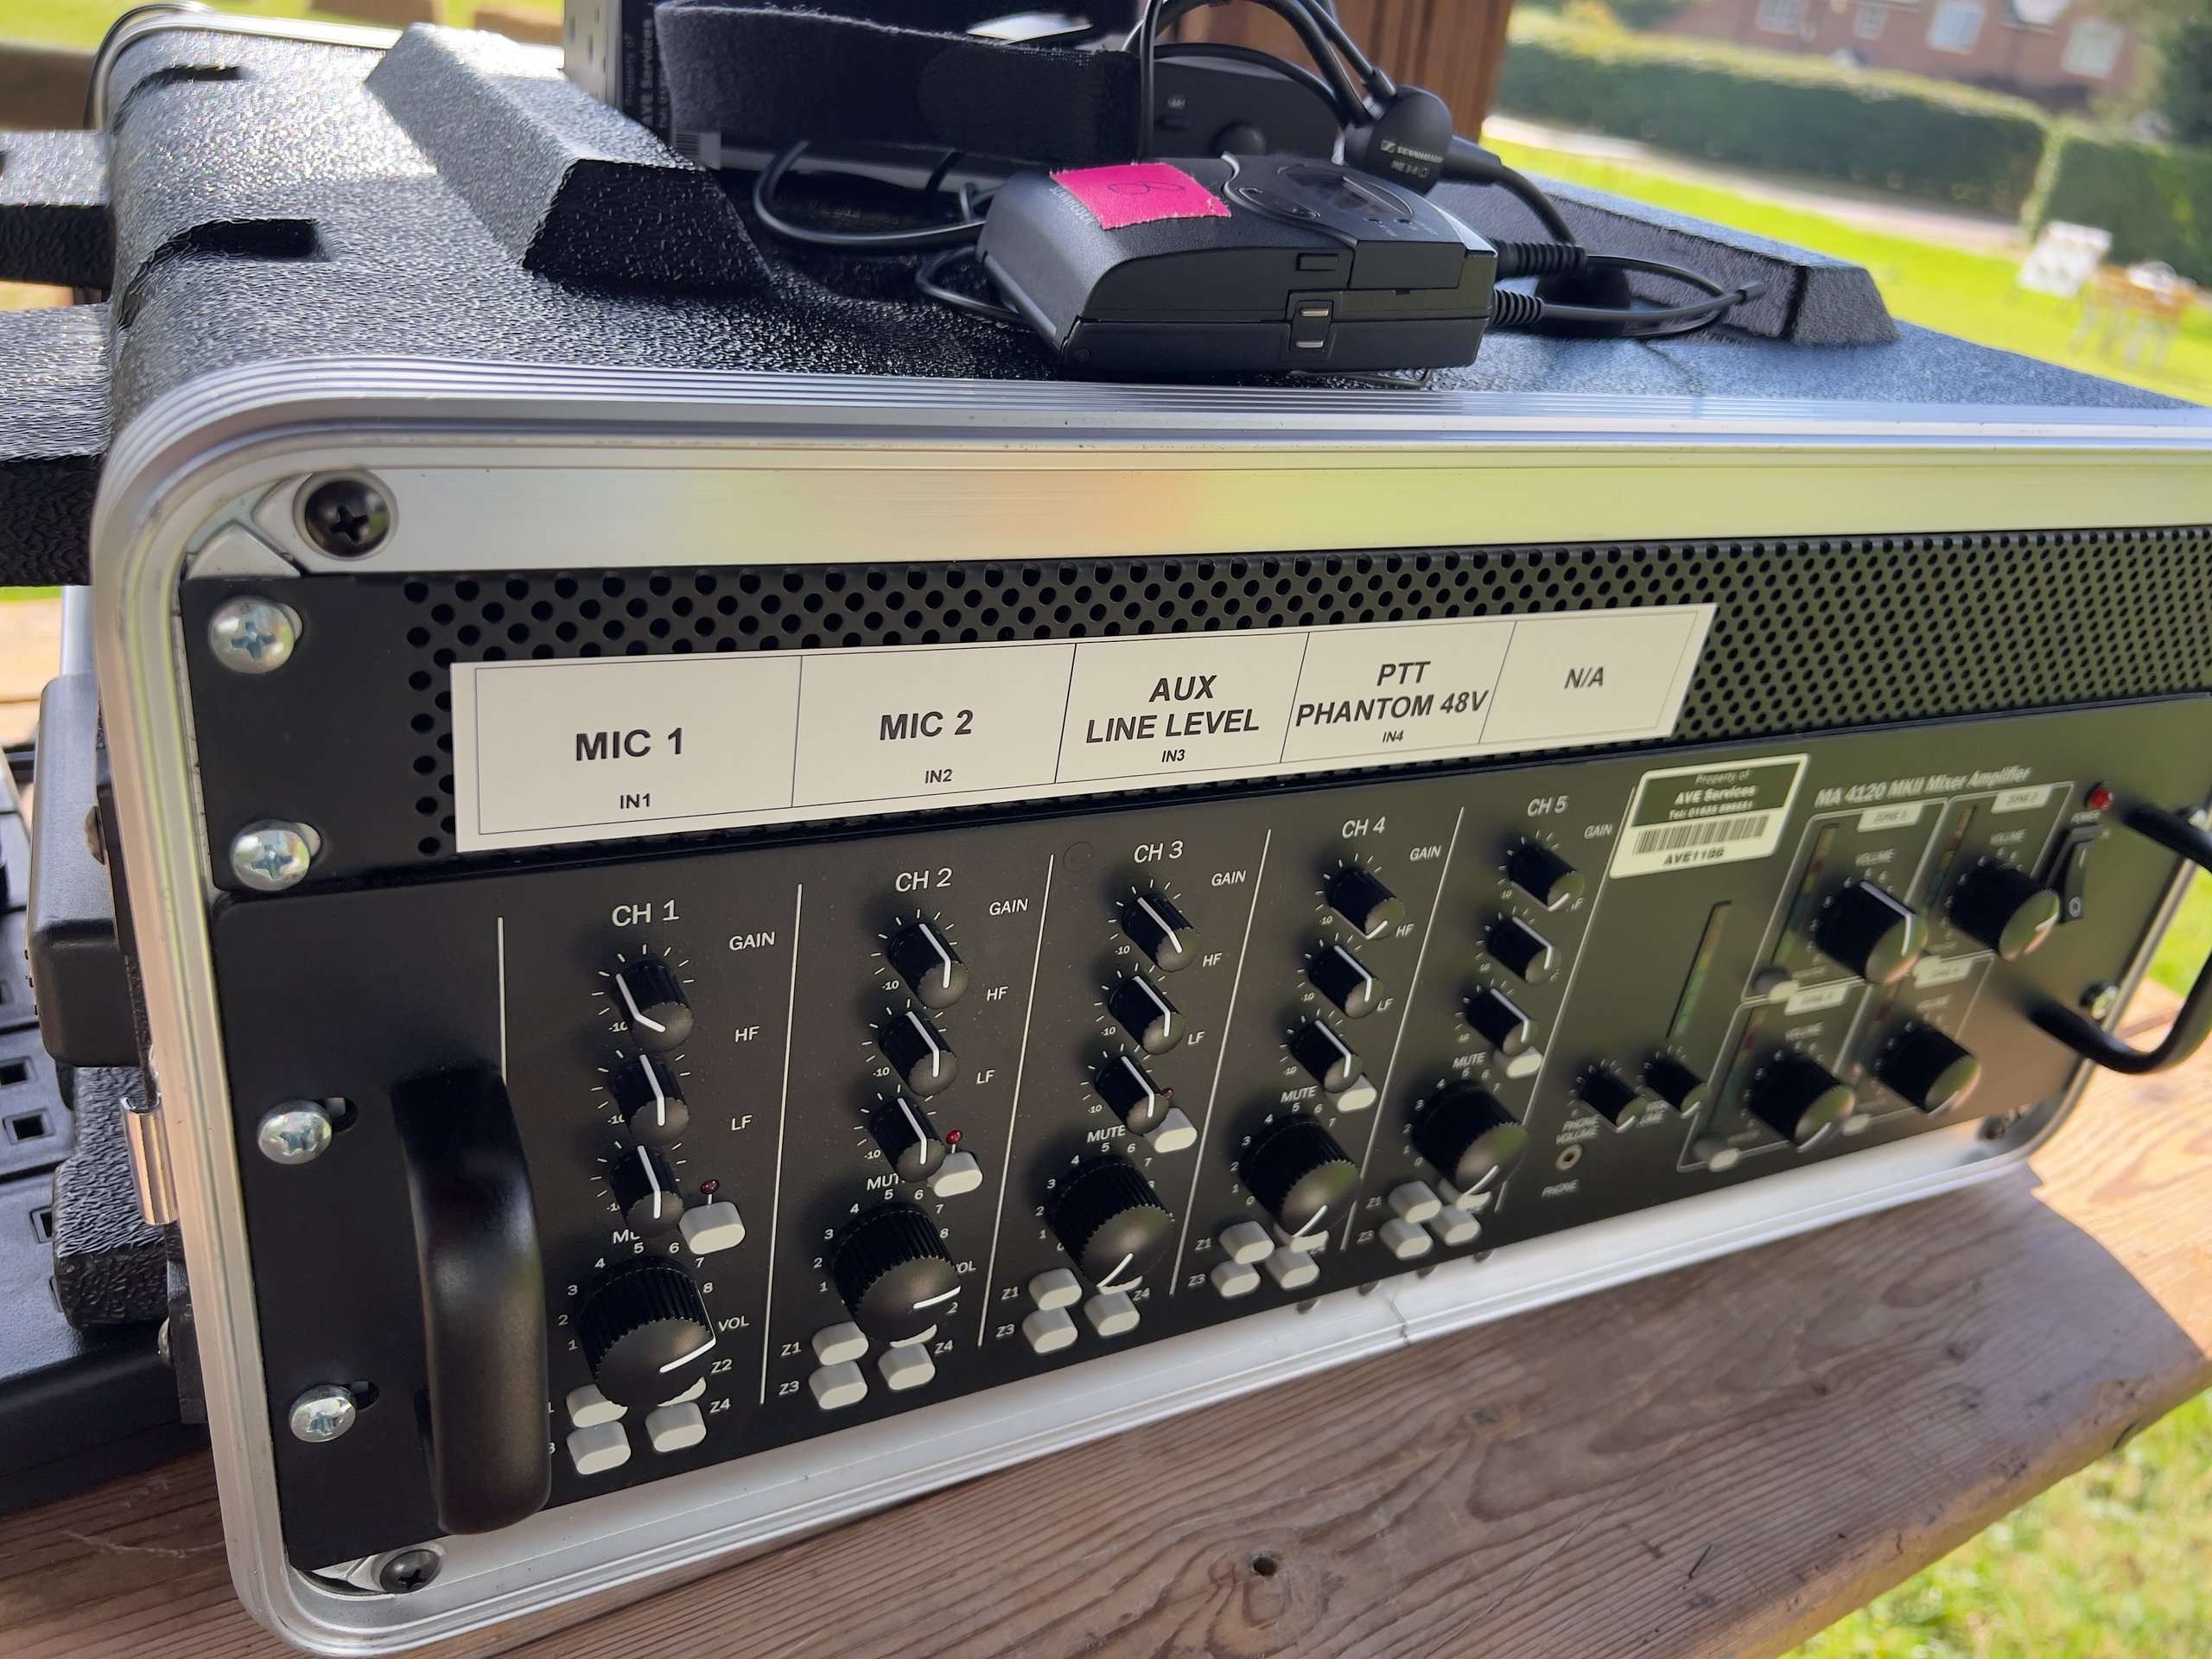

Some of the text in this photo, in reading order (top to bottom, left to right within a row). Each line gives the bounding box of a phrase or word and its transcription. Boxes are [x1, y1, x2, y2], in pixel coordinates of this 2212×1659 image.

[1376, 661, 1430, 686] PTT
[1564, 666, 1605, 690] N/A
[1149, 675, 1216, 702] AUX
[1296, 690, 1489, 727] PHANTOM 48V
[880, 709, 974, 741] MIC 2
[1086, 709, 1260, 744] LINE LEVEL
[1382, 728, 1404, 743] IN4
[575, 728, 683, 761] MIC 1
[1161, 748, 1185, 763] IN3
[925, 769, 953, 784] IN2
[1815, 787, 1842, 808] MA
[1845, 781, 1887, 803] 4120
[1925, 774, 1967, 793] Mixer
[1967, 765, 2031, 788] Amplifier
[620, 793, 652, 810] IN1
[1675, 785, 1758, 805] AVE Services
[1527, 795, 1569, 817] CH 5
[1342, 816, 1386, 839] CH 4
[1584, 823, 1613, 840] GAIN
[1134, 841, 1185, 863] CH 3
[1409, 845, 1441, 862] GAIN
[895, 868, 953, 893] CH 2
[1211, 870, 1246, 887] GAIN
[612, 899, 680, 926] CH 1
[988, 898, 1028, 916] GAIN
[1395, 923, 1414, 938] HF
[729, 931, 775, 950] GAIN
[1202, 952, 1223, 967] HF
[881, 980, 899, 991] -10
[987, 986, 1008, 1001] HF
[1376, 998, 1394, 1012] LF
[734, 1027, 760, 1042] HF
[1187, 1031, 1205, 1046] LF
[1452, 1052, 1488, 1069] MUTE
[873, 1066, 890, 1077] -10
[976, 1070, 995, 1084] LF
[1281, 1084, 1318, 1103] MUTE
[731, 1115, 753, 1130] LF
[1087, 1125, 1126, 1144] MUTE
[864, 1149, 881, 1160] -10
[1101, 1142, 1110, 1153] 5
[1127, 1143, 1136, 1153] 6
[1071, 1154, 1080, 1165] 4
[1144, 1157, 1153, 1167] 7
[867, 1173, 905, 1191] MUT
[1046, 1179, 1056, 1189] 3
[884, 1189, 893, 1199] 5
[914, 1189, 924, 1200] 6
[849, 1203, 860, 1214] 4
[936, 1204, 944, 1214] 7
[1035, 1206, 1046, 1217] 2
[824, 1229, 834, 1240] 3
[939, 1228, 949, 1238] 8
[1039, 1230, 1046, 1239] 1
[634, 1243, 645, 1254] 5
[669, 1242, 680, 1254] 6
[1195, 1237, 1211, 1252] Z1
[594, 1257, 605, 1268] 4
[696, 1257, 705, 1268] 7
[813, 1257, 823, 1268] 2
[957, 1261, 976, 1274] OL
[703, 1282, 714, 1293] 8
[820, 1282, 828, 1292] 1
[1187, 1273, 1206, 1288] Z3
[568, 1285, 578, 1295] 3
[1001, 1287, 1020, 1300] Z1
[1133, 1287, 1151, 1301] Z4
[558, 1315, 569, 1325] 2
[718, 1317, 750, 1332] VOL
[995, 1324, 1015, 1338] Z3
[568, 1340, 577, 1350] 1
[781, 1341, 802, 1357] Z1
[934, 1339, 954, 1355] Z4
[710, 1359, 733, 1374] Z2
[779, 1380, 800, 1396] Z3
[709, 1397, 732, 1414] Z4
